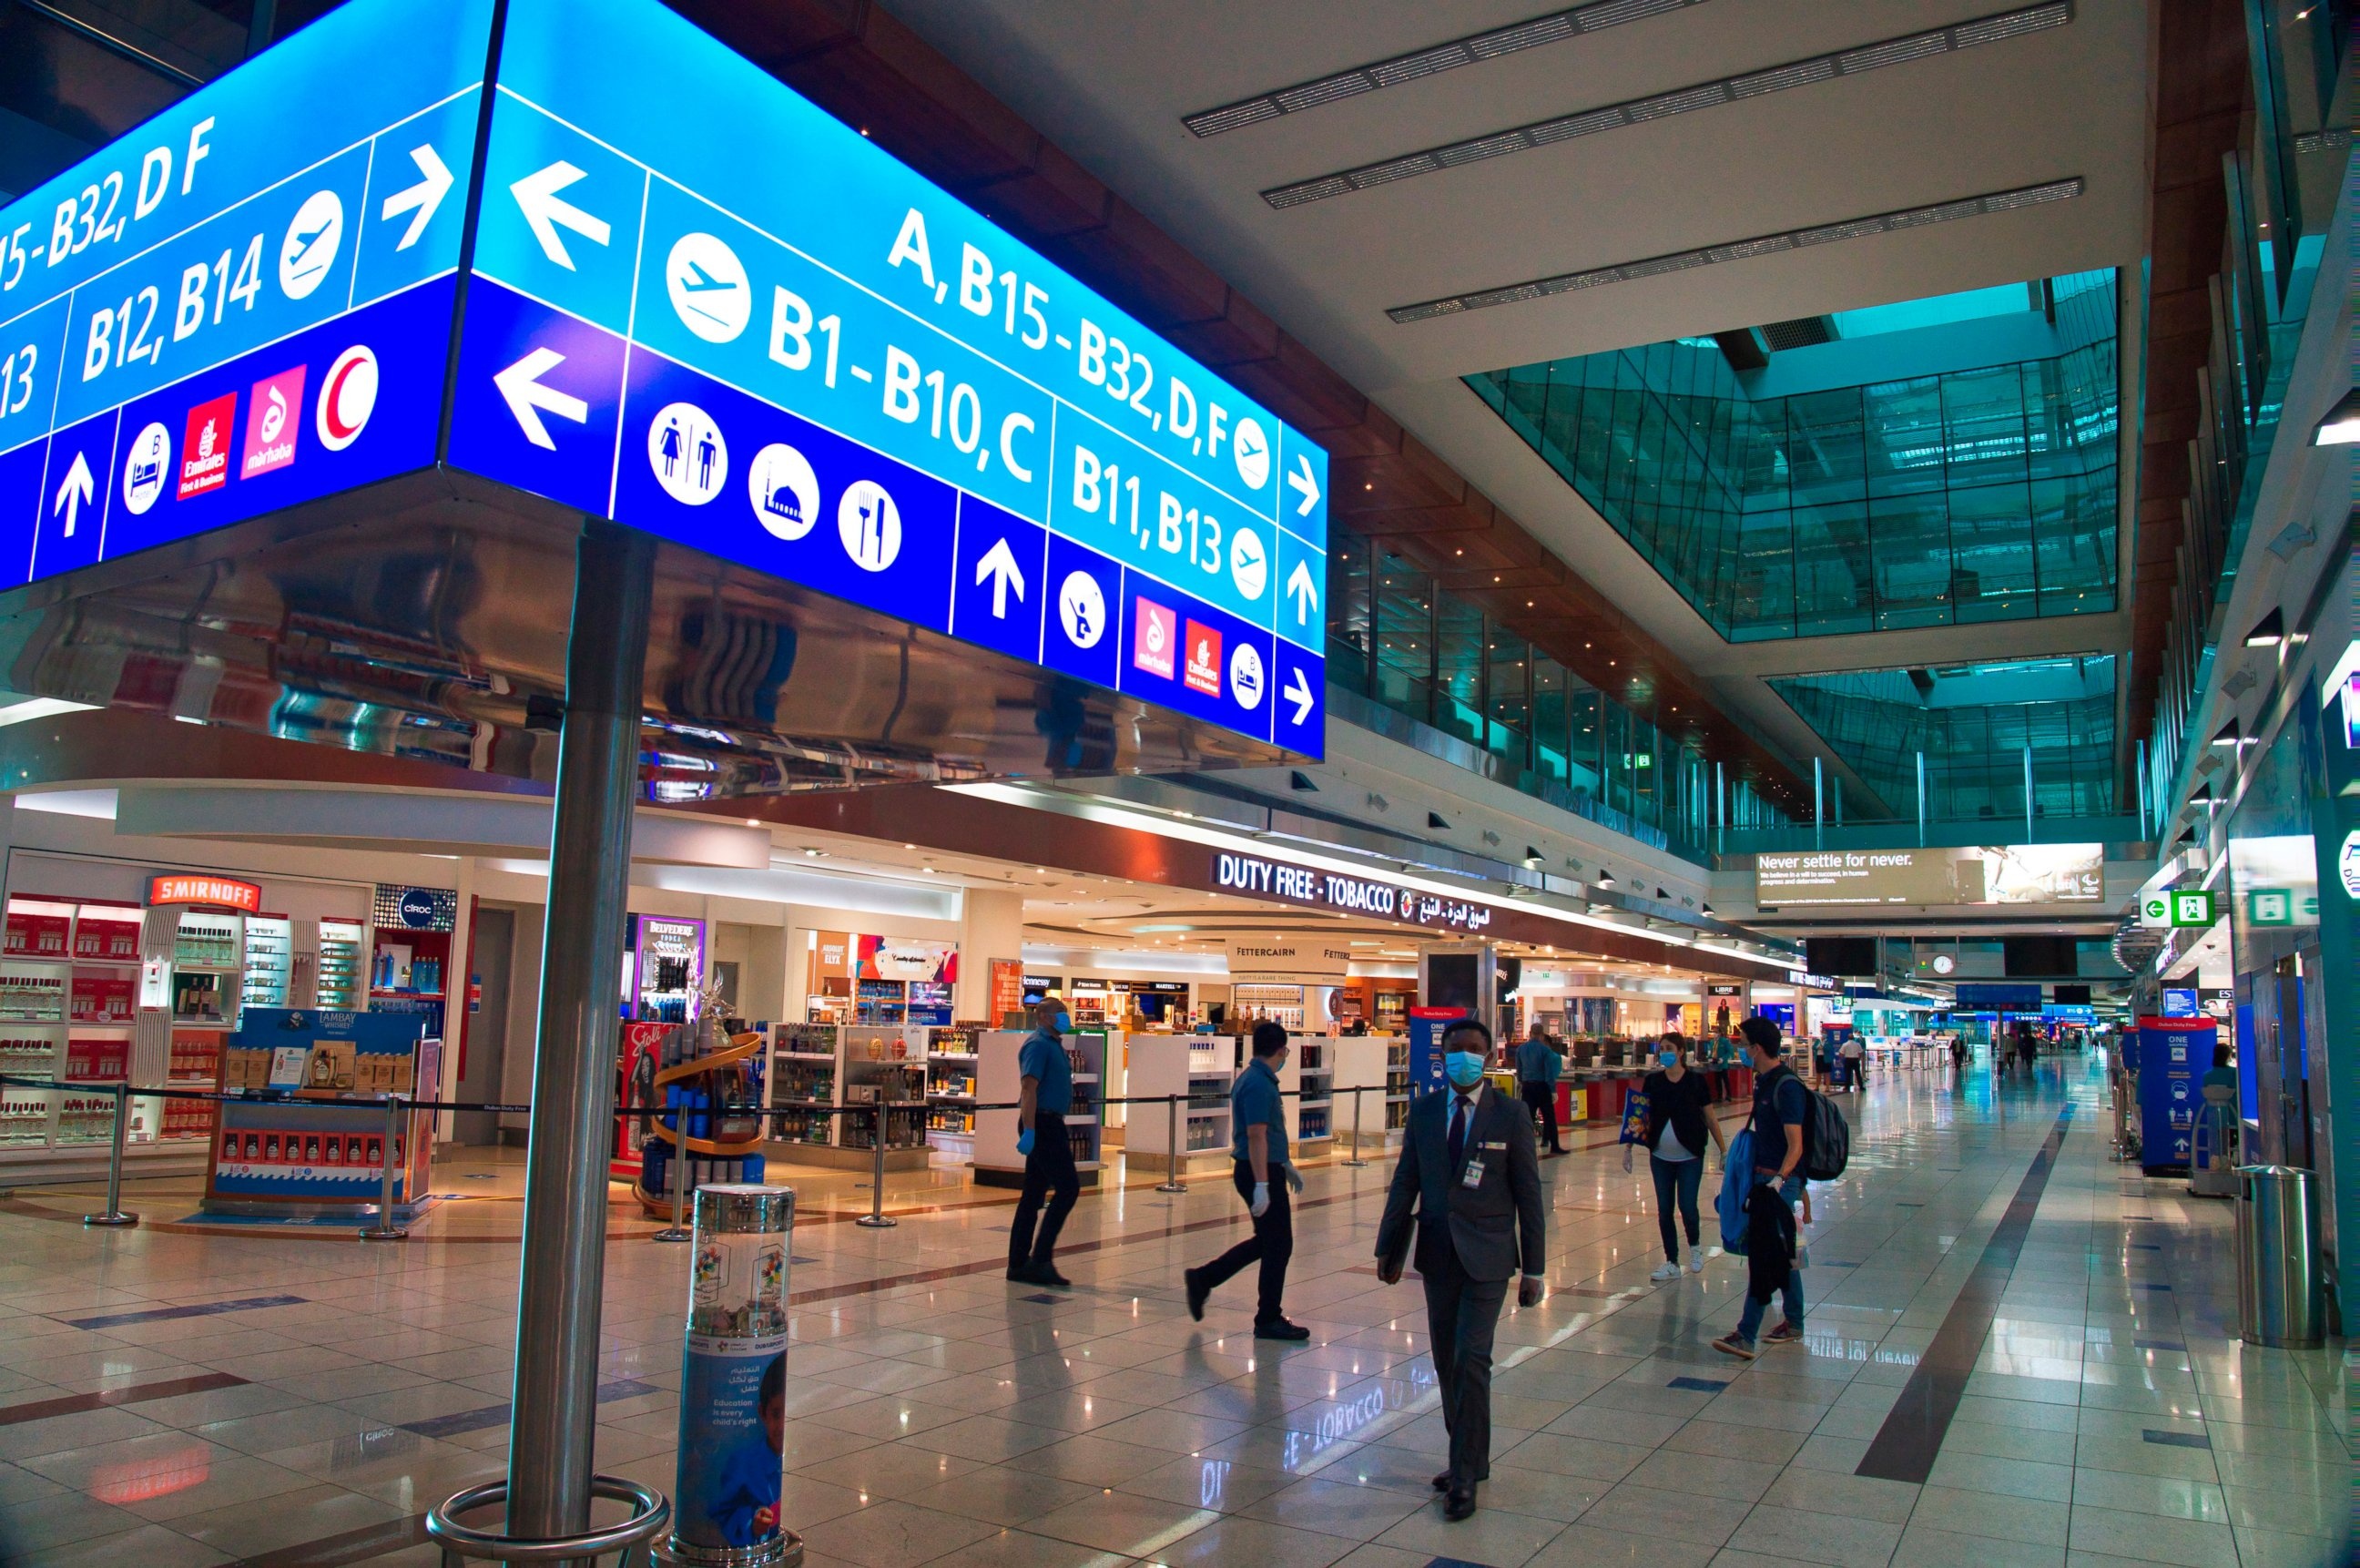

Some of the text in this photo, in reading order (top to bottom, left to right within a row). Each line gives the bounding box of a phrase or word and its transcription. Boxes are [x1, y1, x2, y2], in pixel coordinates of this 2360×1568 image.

[152, 434, 160, 456] B
[185, 453, 225, 478] Emirates
[180, 482, 194, 494] First
[199, 472, 225, 488] Business
[1188, 658, 1217, 682] Emirates
[1759, 853, 1912, 869] Never settle for never.
[1219, 853, 1272, 892] DUTY
[1276, 866, 1314, 901] FREE
[1326, 876, 1394, 915] TOBACCO
[649, 921, 694, 936] BELVEDERE
[822, 944, 845, 953] ABSOLUT
[1236, 947, 1296, 957] FETTERCAIRN
[824, 954, 840, 965] ELYX
[320, 1012, 356, 1023] LAMBAY
[714, 1399, 753, 1407] Education
[713, 1417, 757, 1428] child's right
